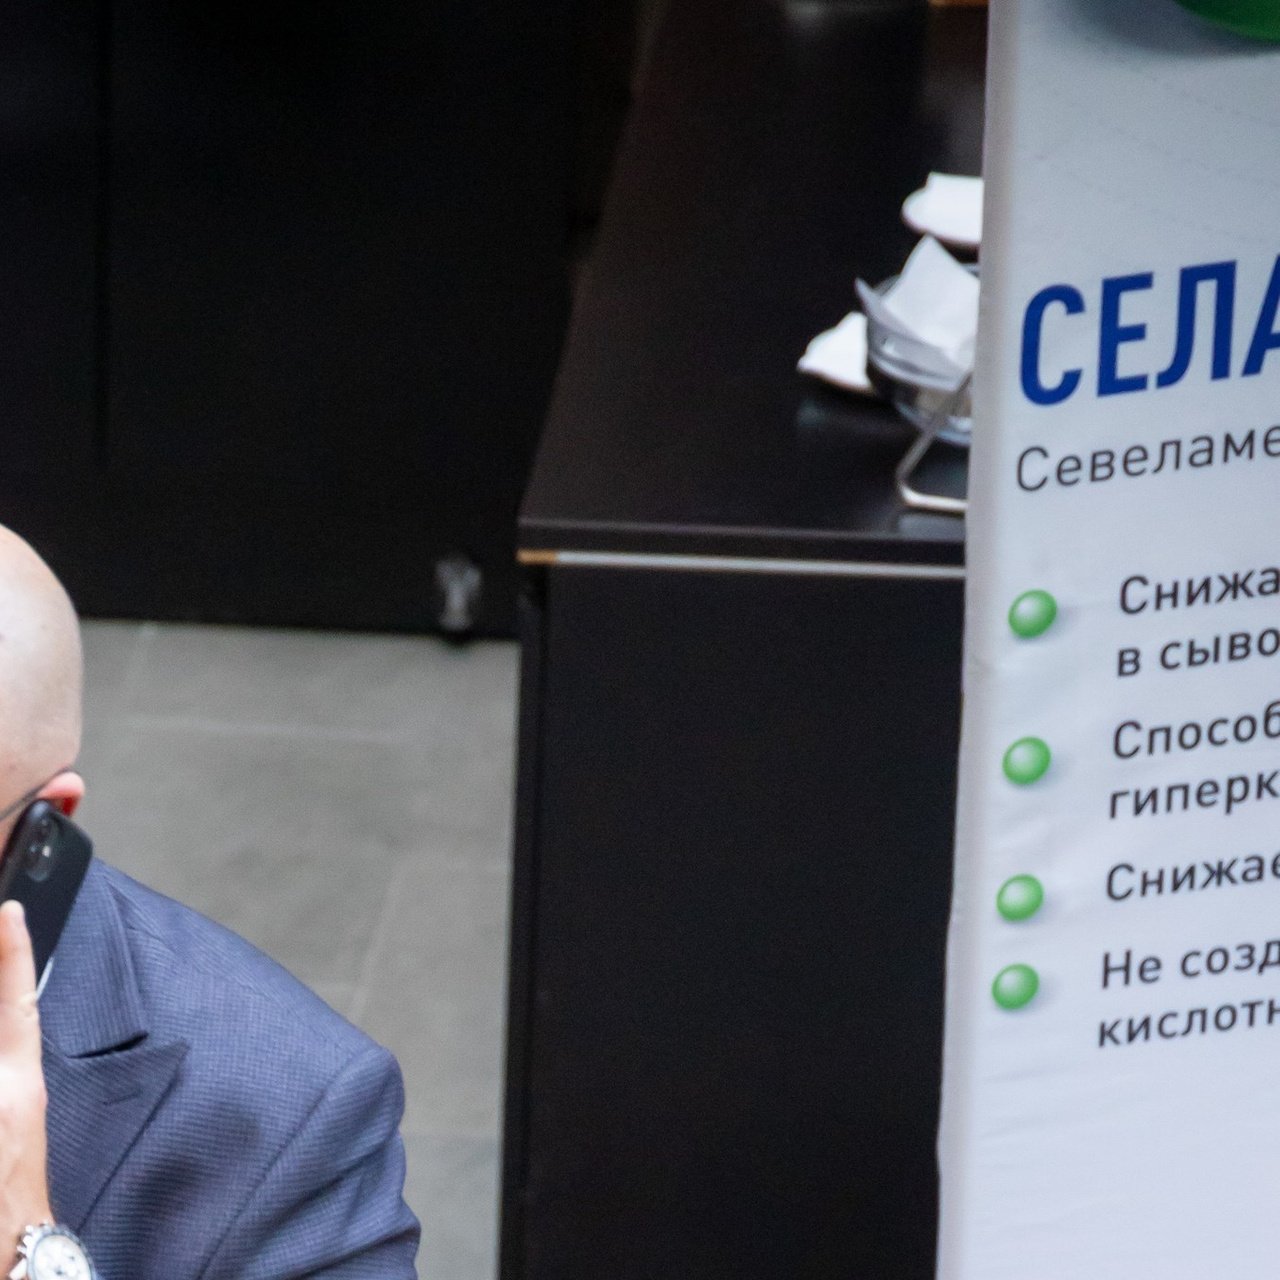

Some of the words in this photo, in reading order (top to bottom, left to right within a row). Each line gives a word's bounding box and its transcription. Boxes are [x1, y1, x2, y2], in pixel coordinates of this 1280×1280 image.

[1016, 425, 1280, 492] Севеламе
[1119, 566, 1280, 615] Снижа
[1117, 647, 1140, 678] в
[1160, 627, 1280, 670] сыво
[1113, 700, 1280, 760] Способ
[1109, 770, 1280, 820] гиперк
[1102, 949, 1162, 990] Не
[1181, 940, 1280, 979] созд
